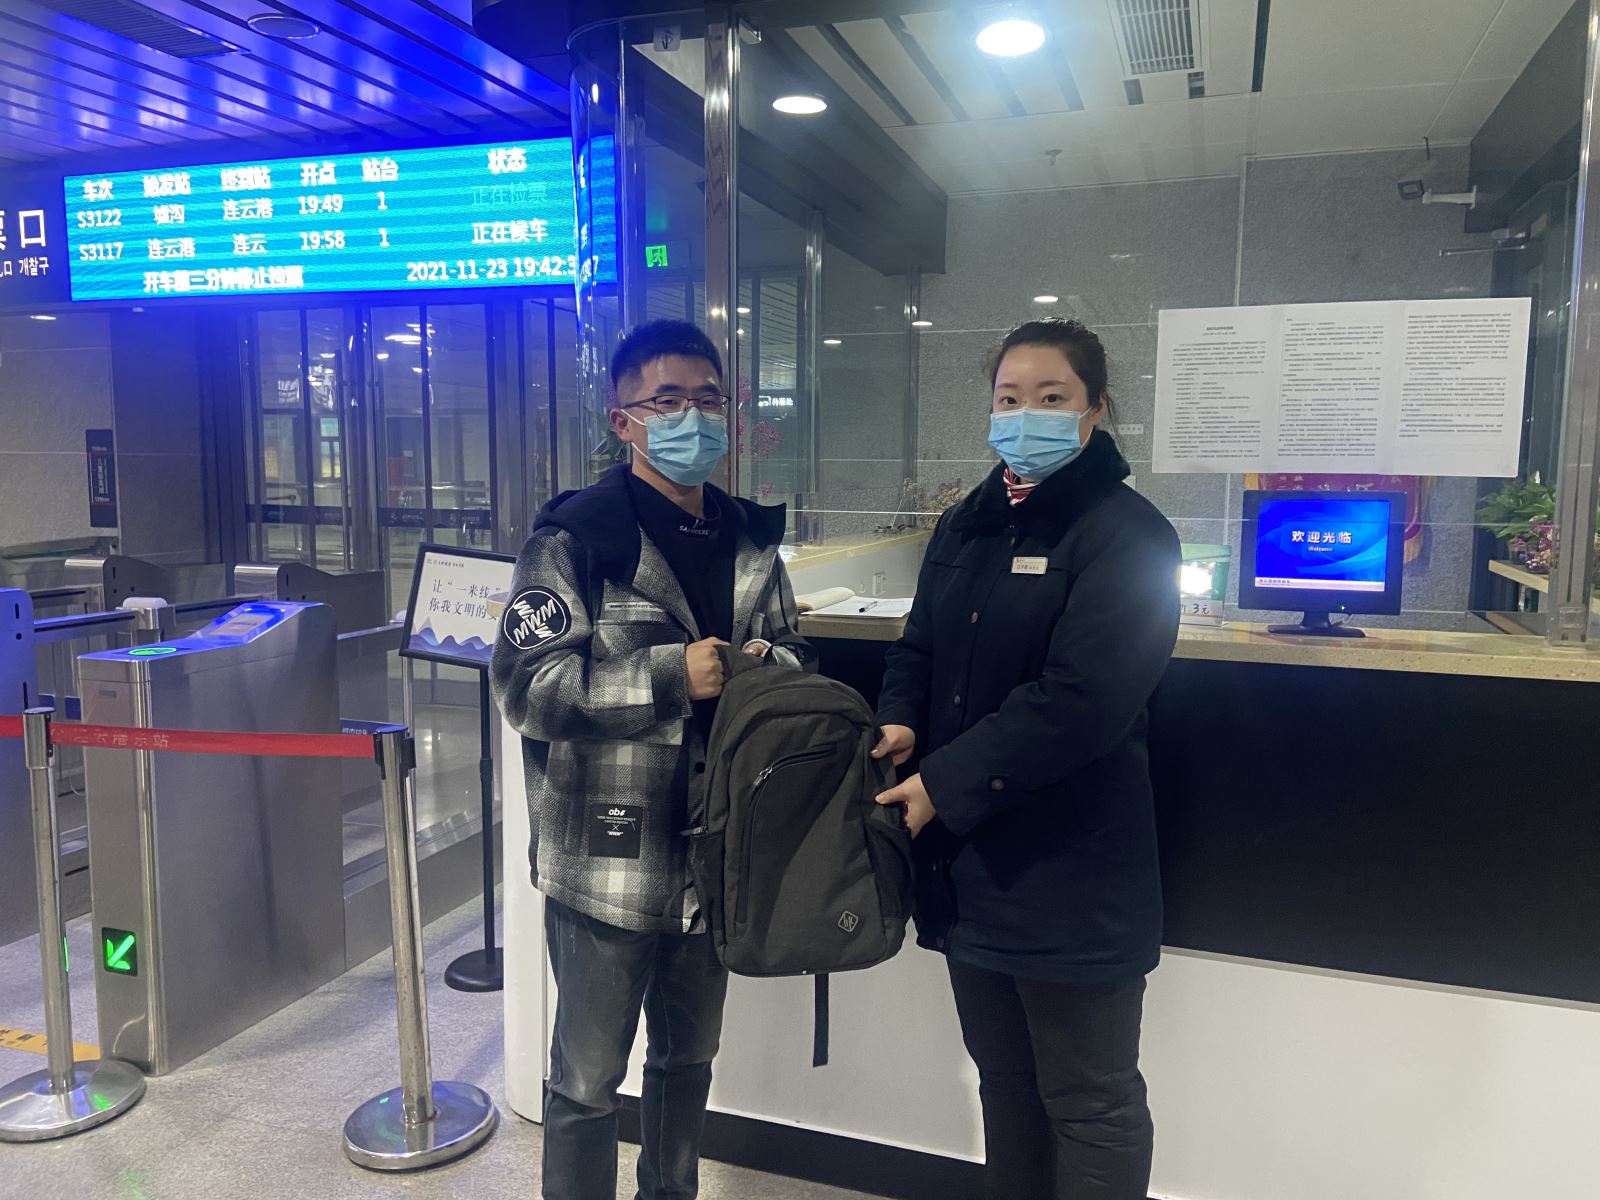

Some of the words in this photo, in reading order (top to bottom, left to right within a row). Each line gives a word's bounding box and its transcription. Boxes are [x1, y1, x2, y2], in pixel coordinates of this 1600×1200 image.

[83, 179, 114, 202] 车次
[300, 161, 336, 186] 开点
[362, 157, 399, 183] 站台
[487, 147, 528, 175] 状态
[77, 208, 122, 229] S3122
[222, 198, 273, 221] 连云港
[297, 194, 343, 215] 19:49
[376, 191, 388, 211] 1
[471, 181, 549, 207] 正在检票
[0, 209, 46, 250] 口
[79, 242, 124, 261] S3117
[147, 237, 196, 260] 连云港
[232, 233, 267, 256] 连云
[300, 230, 346, 250] 19:58
[379, 228, 390, 248] 1
[471, 218, 549, 246] 正在候车
[18, 256, 50, 276] 개찰구
[406, 258, 508, 283] 2021-11-23
[1291, 530, 1353, 545] 欢迎光临
[429, 597, 497, 620] 你我文明的
